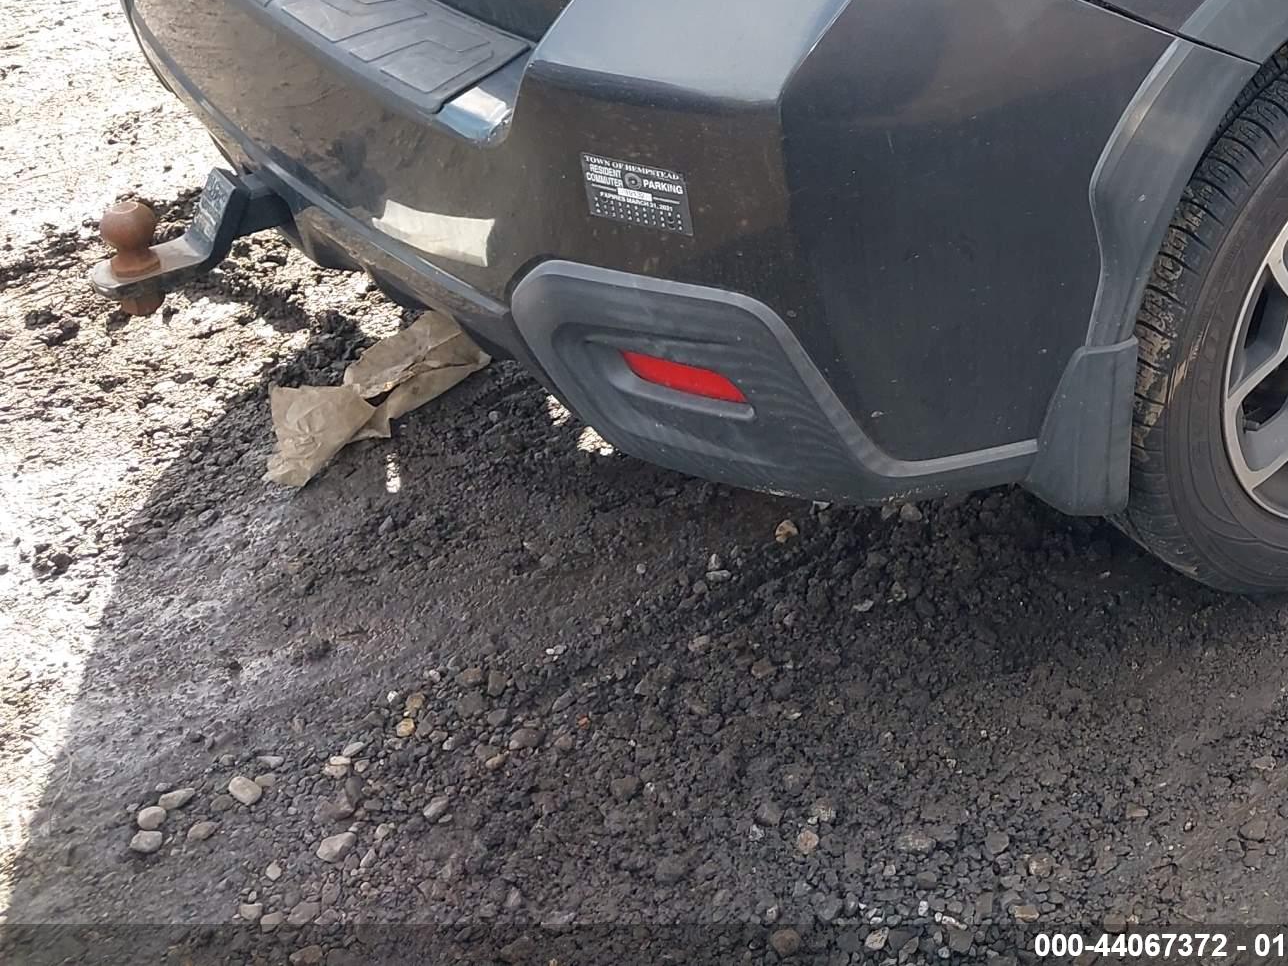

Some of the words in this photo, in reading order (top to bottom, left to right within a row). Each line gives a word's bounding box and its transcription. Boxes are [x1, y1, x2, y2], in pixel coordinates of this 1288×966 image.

[583, 155, 611, 166] TOWN
[612, 161, 624, 169] OF
[625, 164, 680, 180] HEMPSTEAD
[589, 164, 622, 178] RESIDENT
[586, 172, 623, 187] COMMUTER
[642, 179, 684, 194] PARKING
